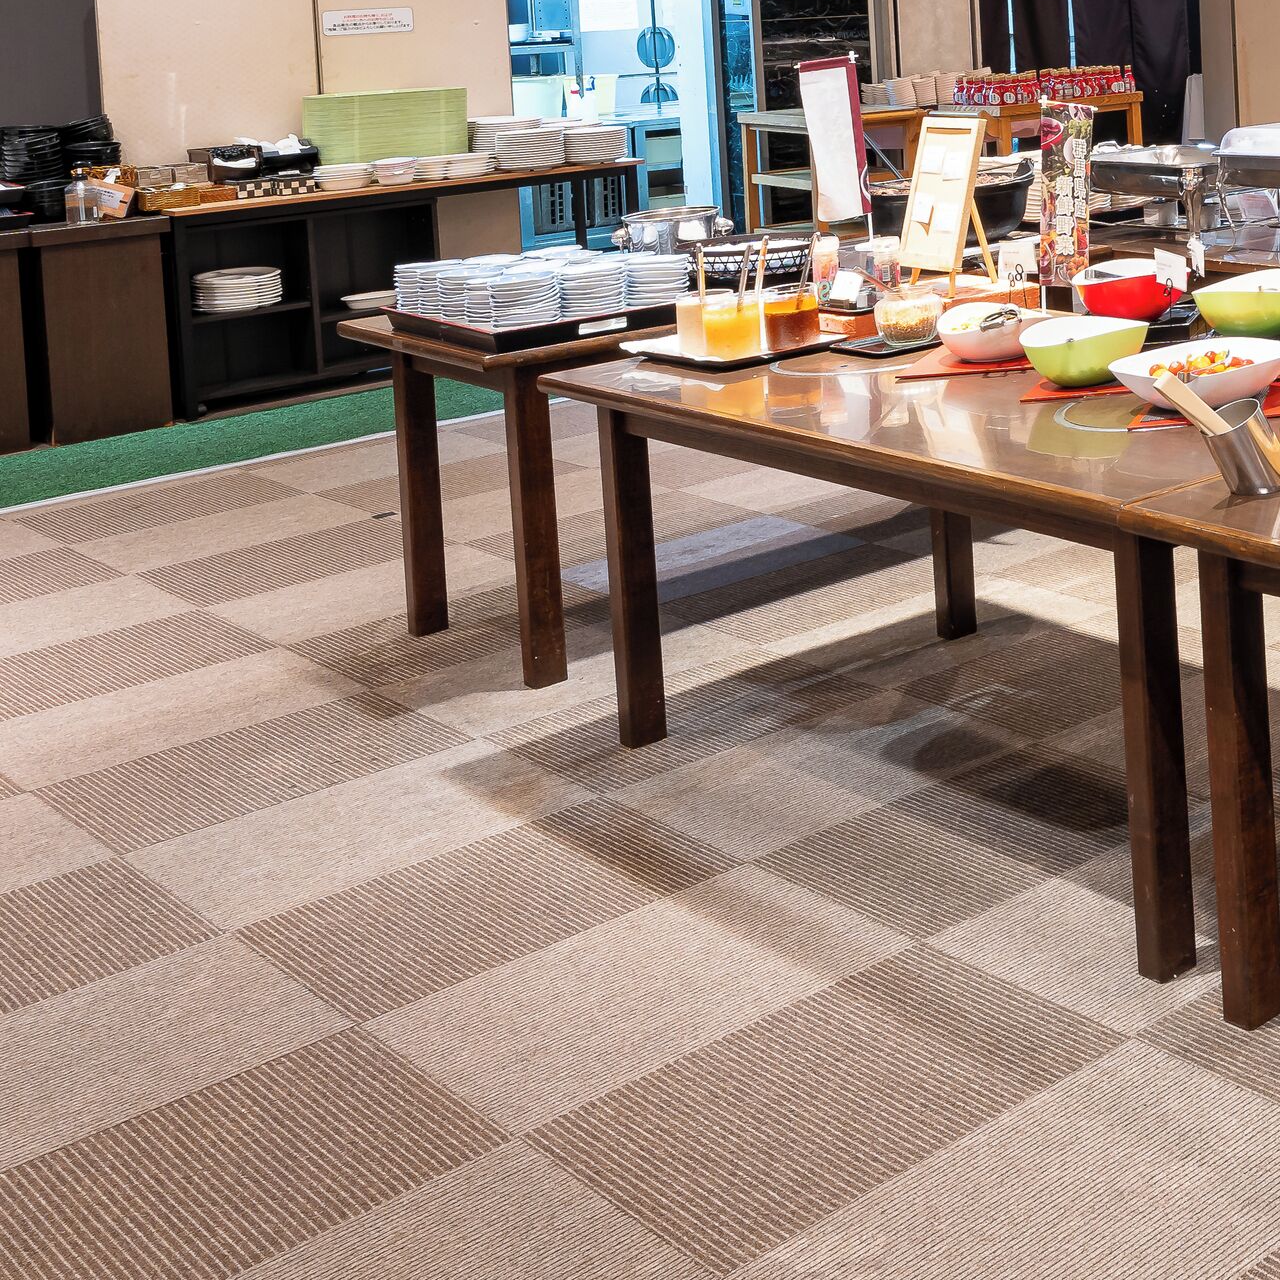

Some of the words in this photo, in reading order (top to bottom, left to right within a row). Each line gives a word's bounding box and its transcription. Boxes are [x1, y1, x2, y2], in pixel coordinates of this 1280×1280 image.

[1055, 175, 1074, 256] 新鮮野菜
[1073, 139, 1087, 218] 群馬県産
